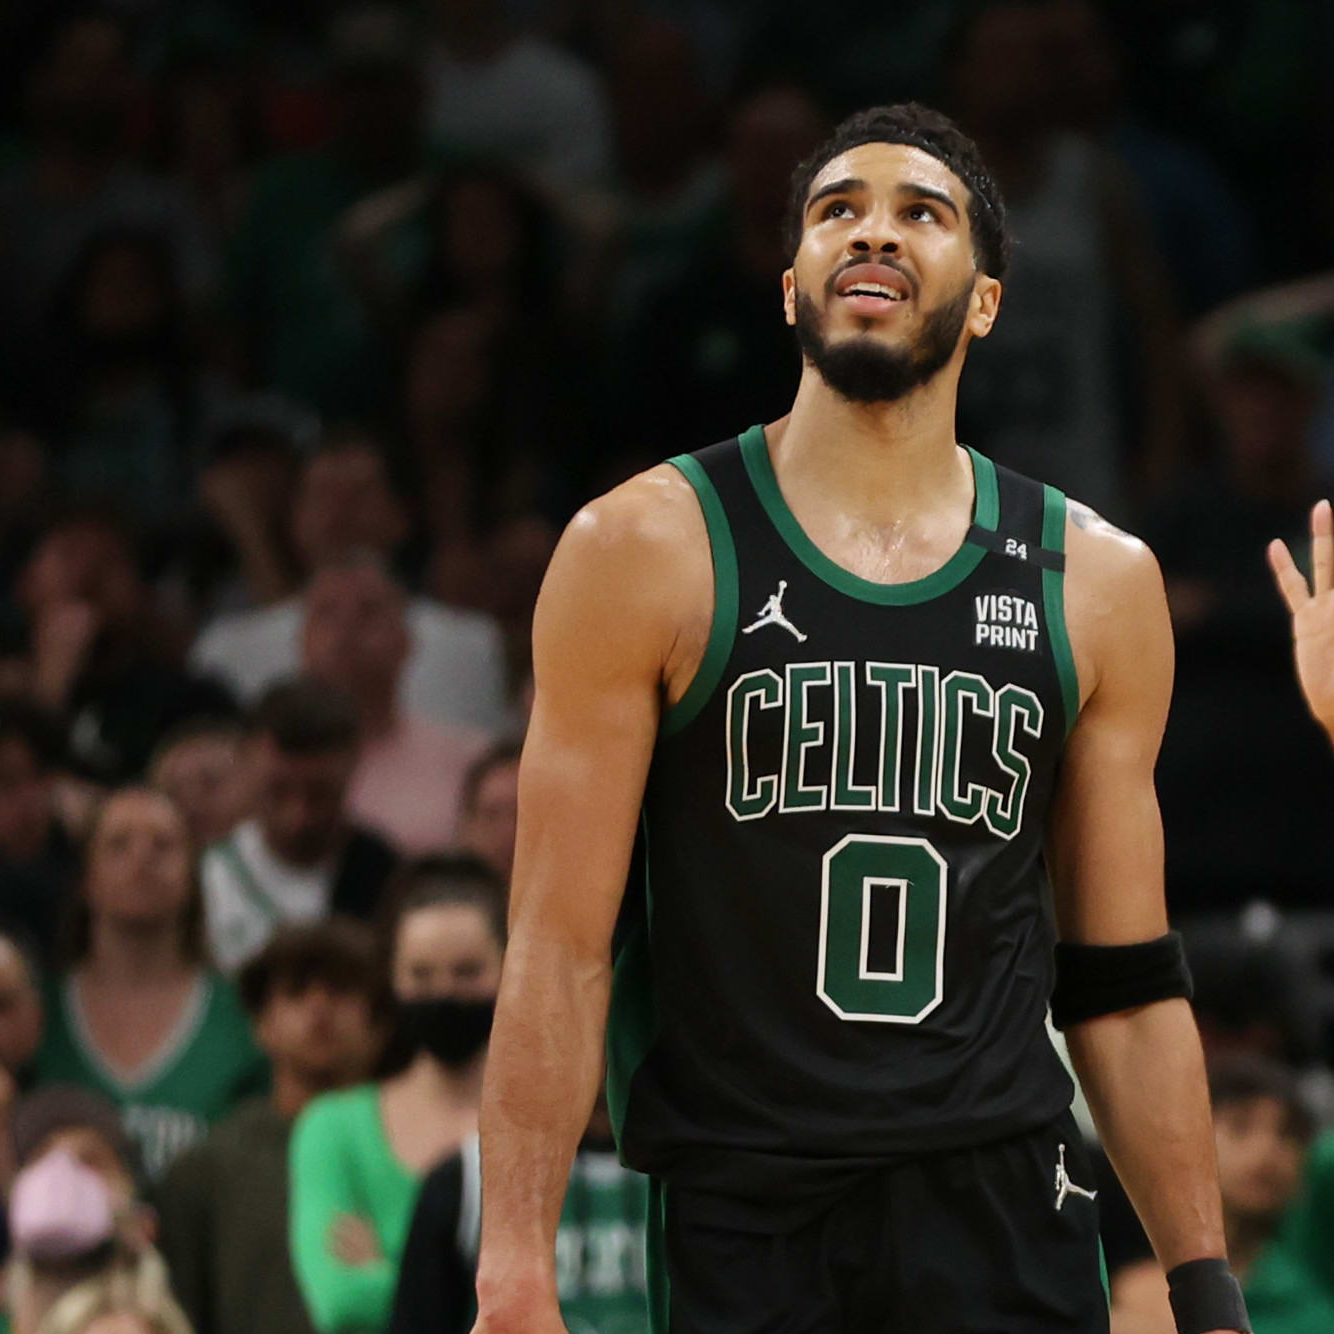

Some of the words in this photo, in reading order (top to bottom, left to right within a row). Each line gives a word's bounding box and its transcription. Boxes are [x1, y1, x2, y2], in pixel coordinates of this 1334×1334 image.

[1005, 538, 1027, 561] 24
[974, 594, 1038, 630] VISTA
[975, 623, 1039, 651] PRINT
[725, 661, 1044, 840] CELTICS
[816, 833, 948, 1024] 0
